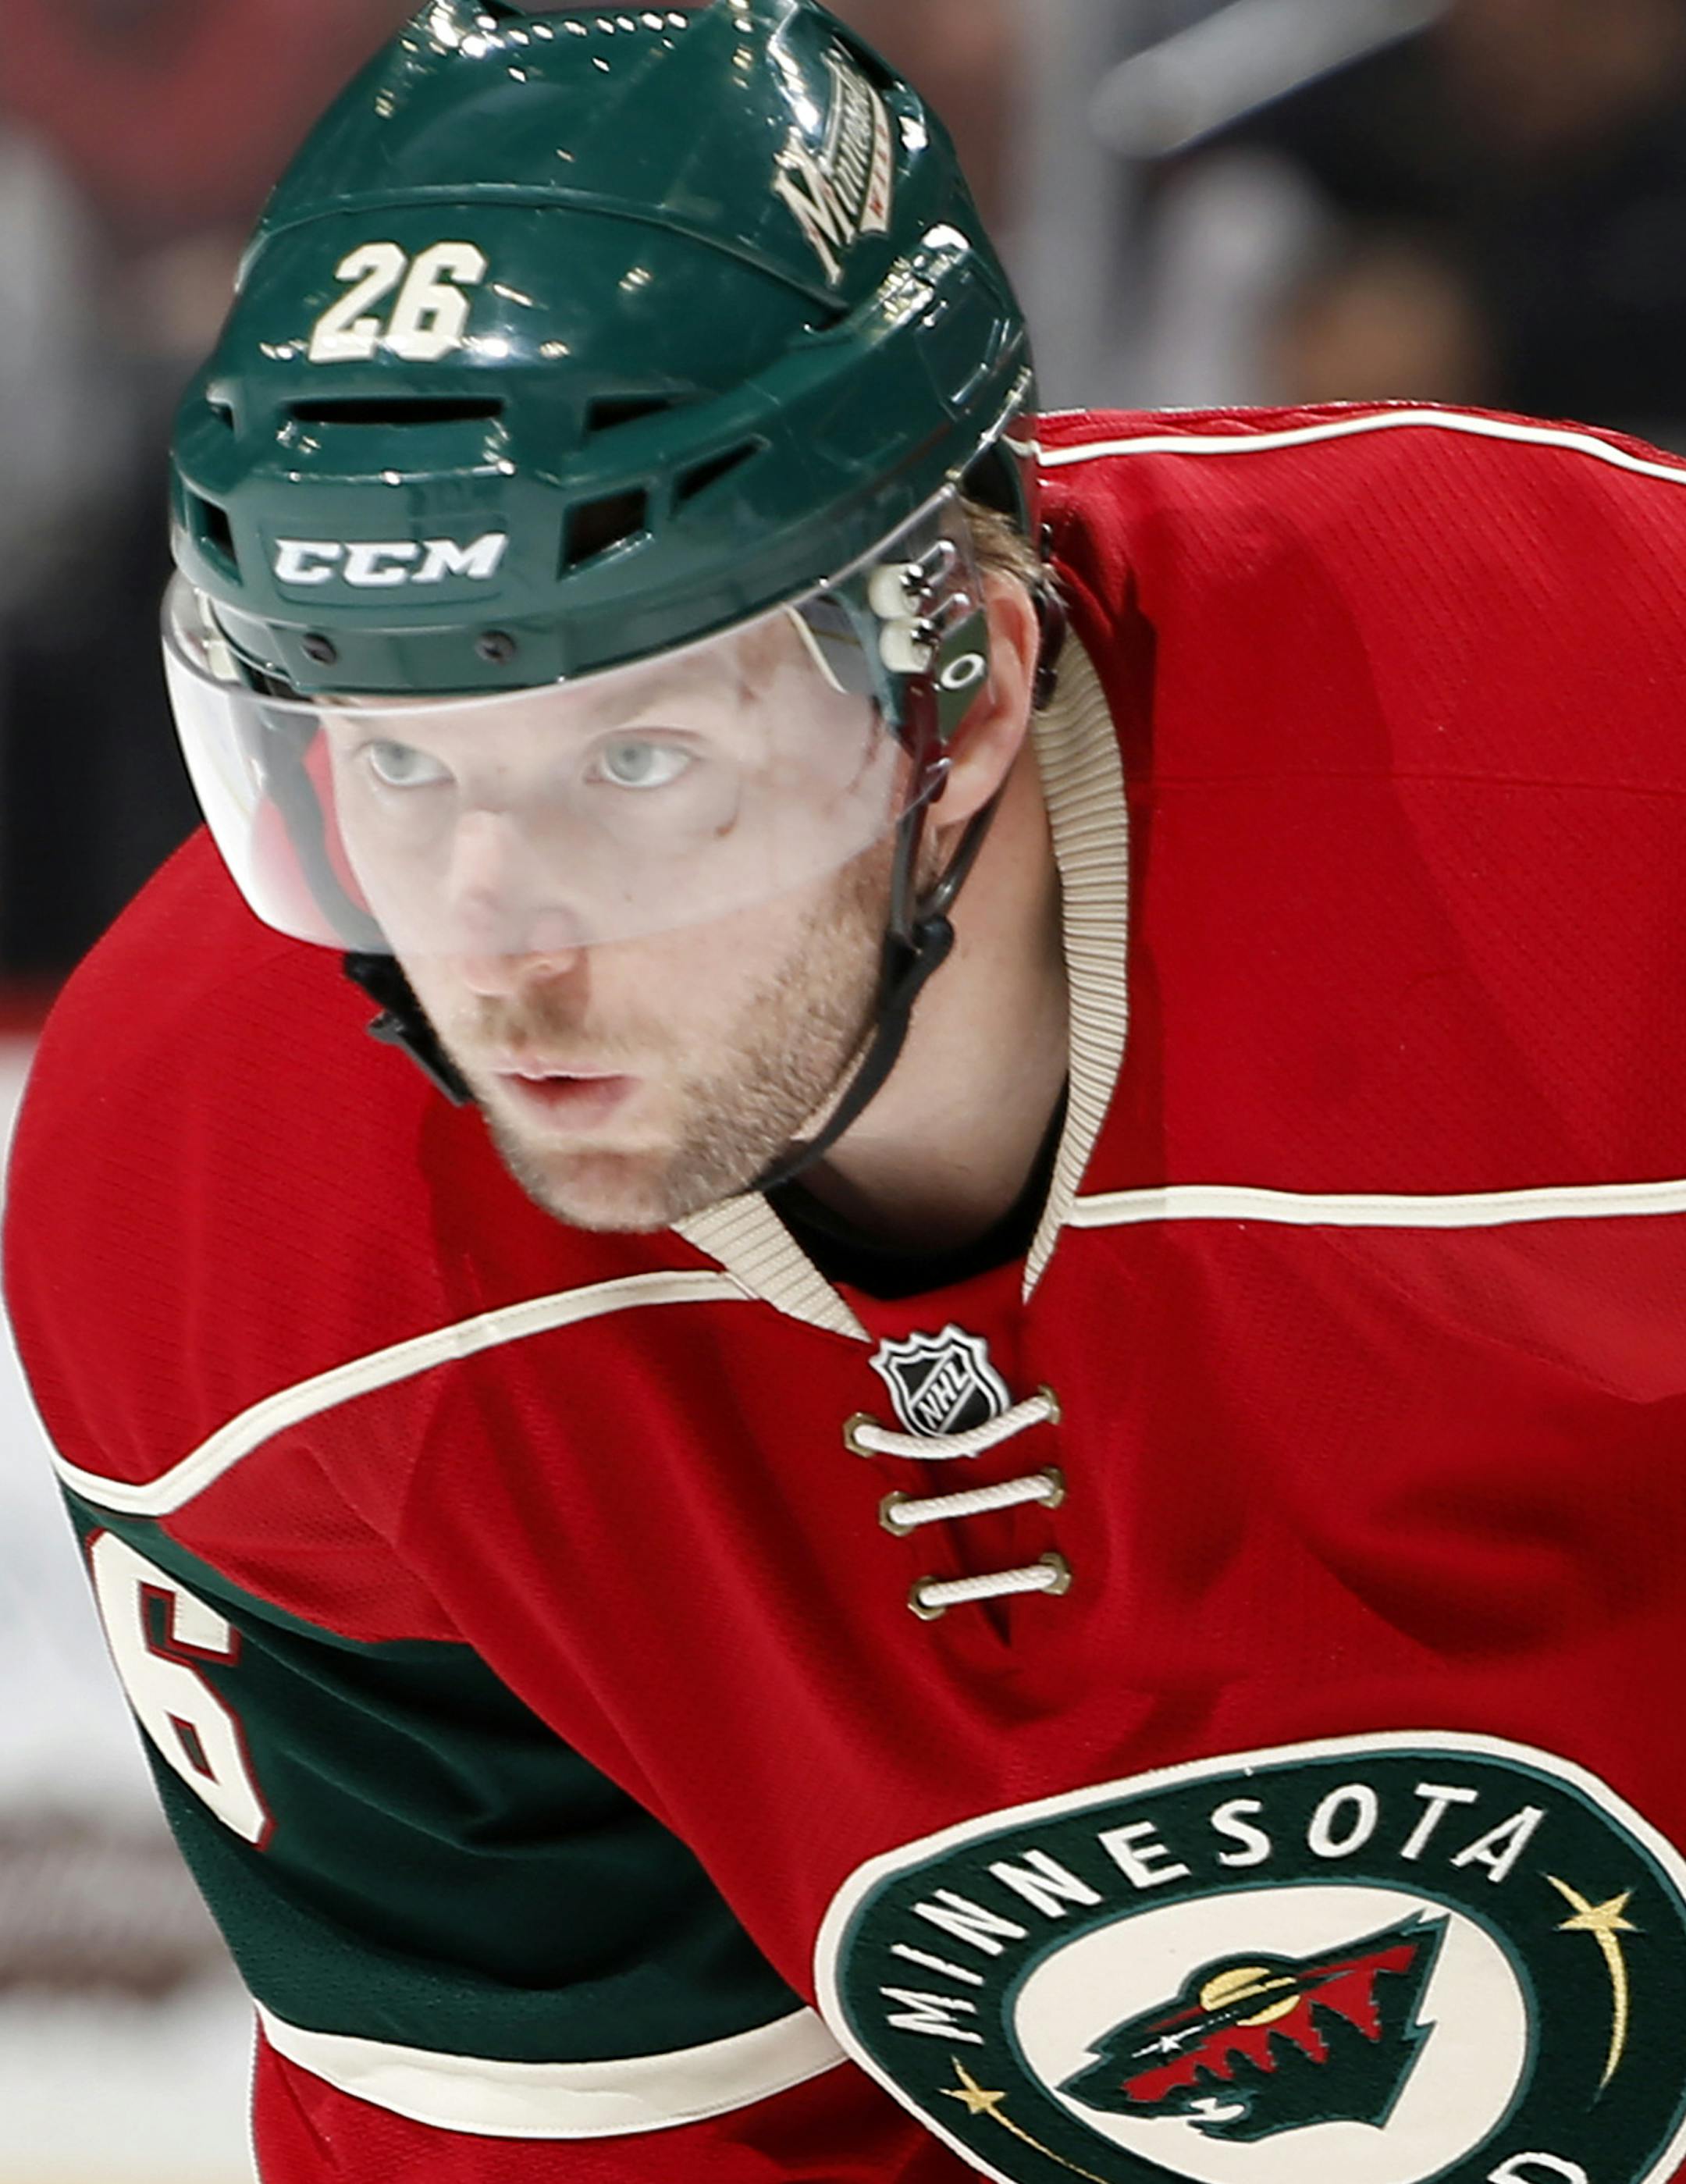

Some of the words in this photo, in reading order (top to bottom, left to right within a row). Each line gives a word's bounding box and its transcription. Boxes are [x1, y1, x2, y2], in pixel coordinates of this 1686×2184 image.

[308, 241, 487, 361] 26
[275, 532, 507, 587] CCM
[916, 1361, 970, 1430] NHL
[86, 1528, 276, 1851] 6
[879, 1782, 1546, 2046] MINNESOTA
